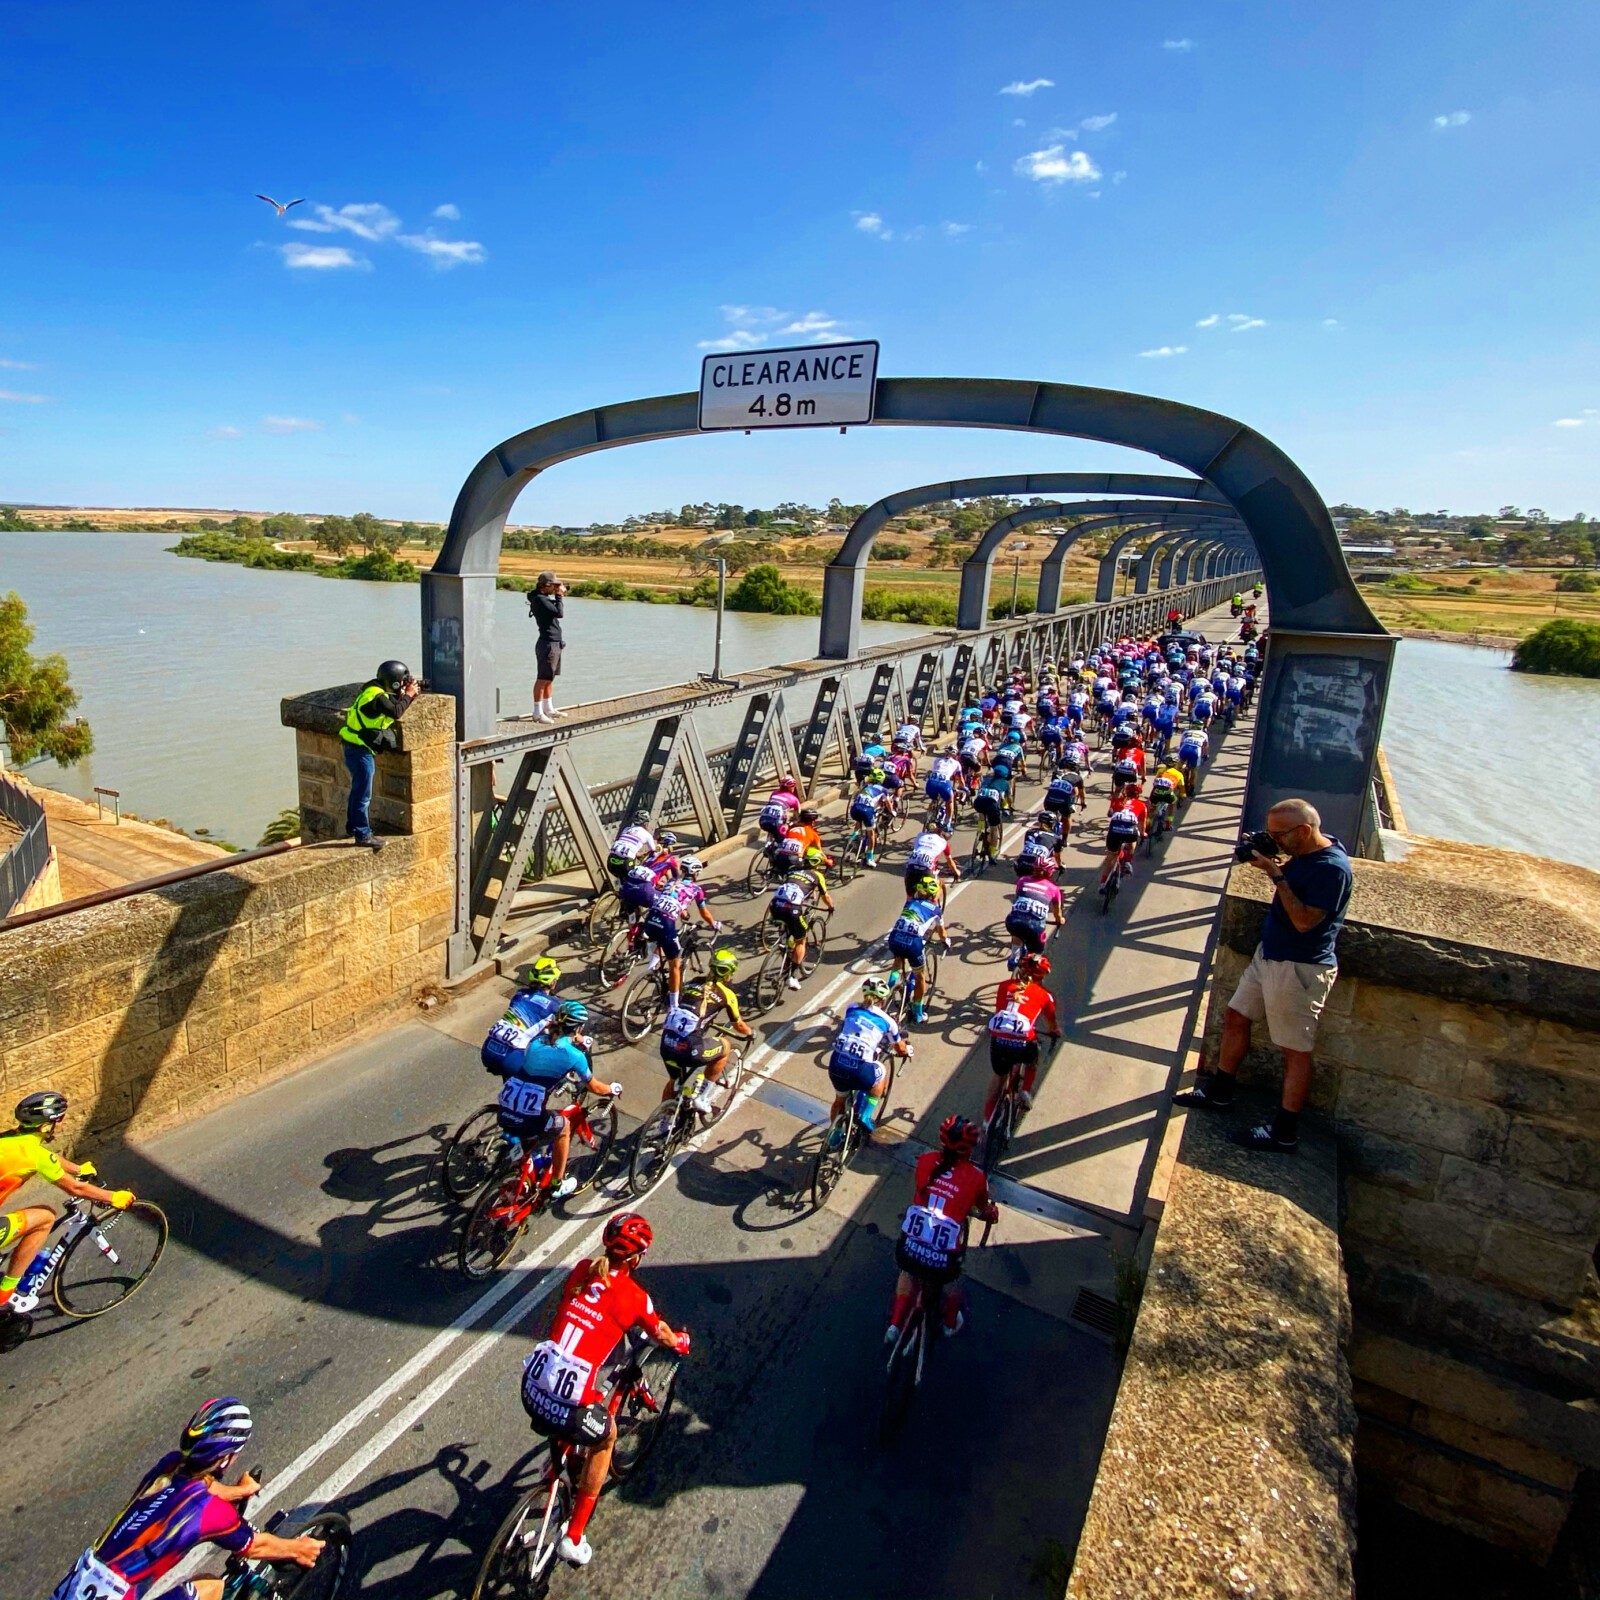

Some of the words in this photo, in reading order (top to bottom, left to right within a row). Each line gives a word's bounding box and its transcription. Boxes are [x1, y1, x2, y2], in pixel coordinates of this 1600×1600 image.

[712, 354, 864, 388] CLEARANCE
[1012, 1020, 1024, 1034] 12
[849, 1042, 865, 1059] 65
[907, 1213, 925, 1237] 15
[932, 1224, 951, 1250] 15
[570, 1297, 603, 1322] Sunweb
[527, 1350, 548, 1380] 16
[552, 1367, 578, 1399] 16
[525, 1380, 570, 1418] RENSON
